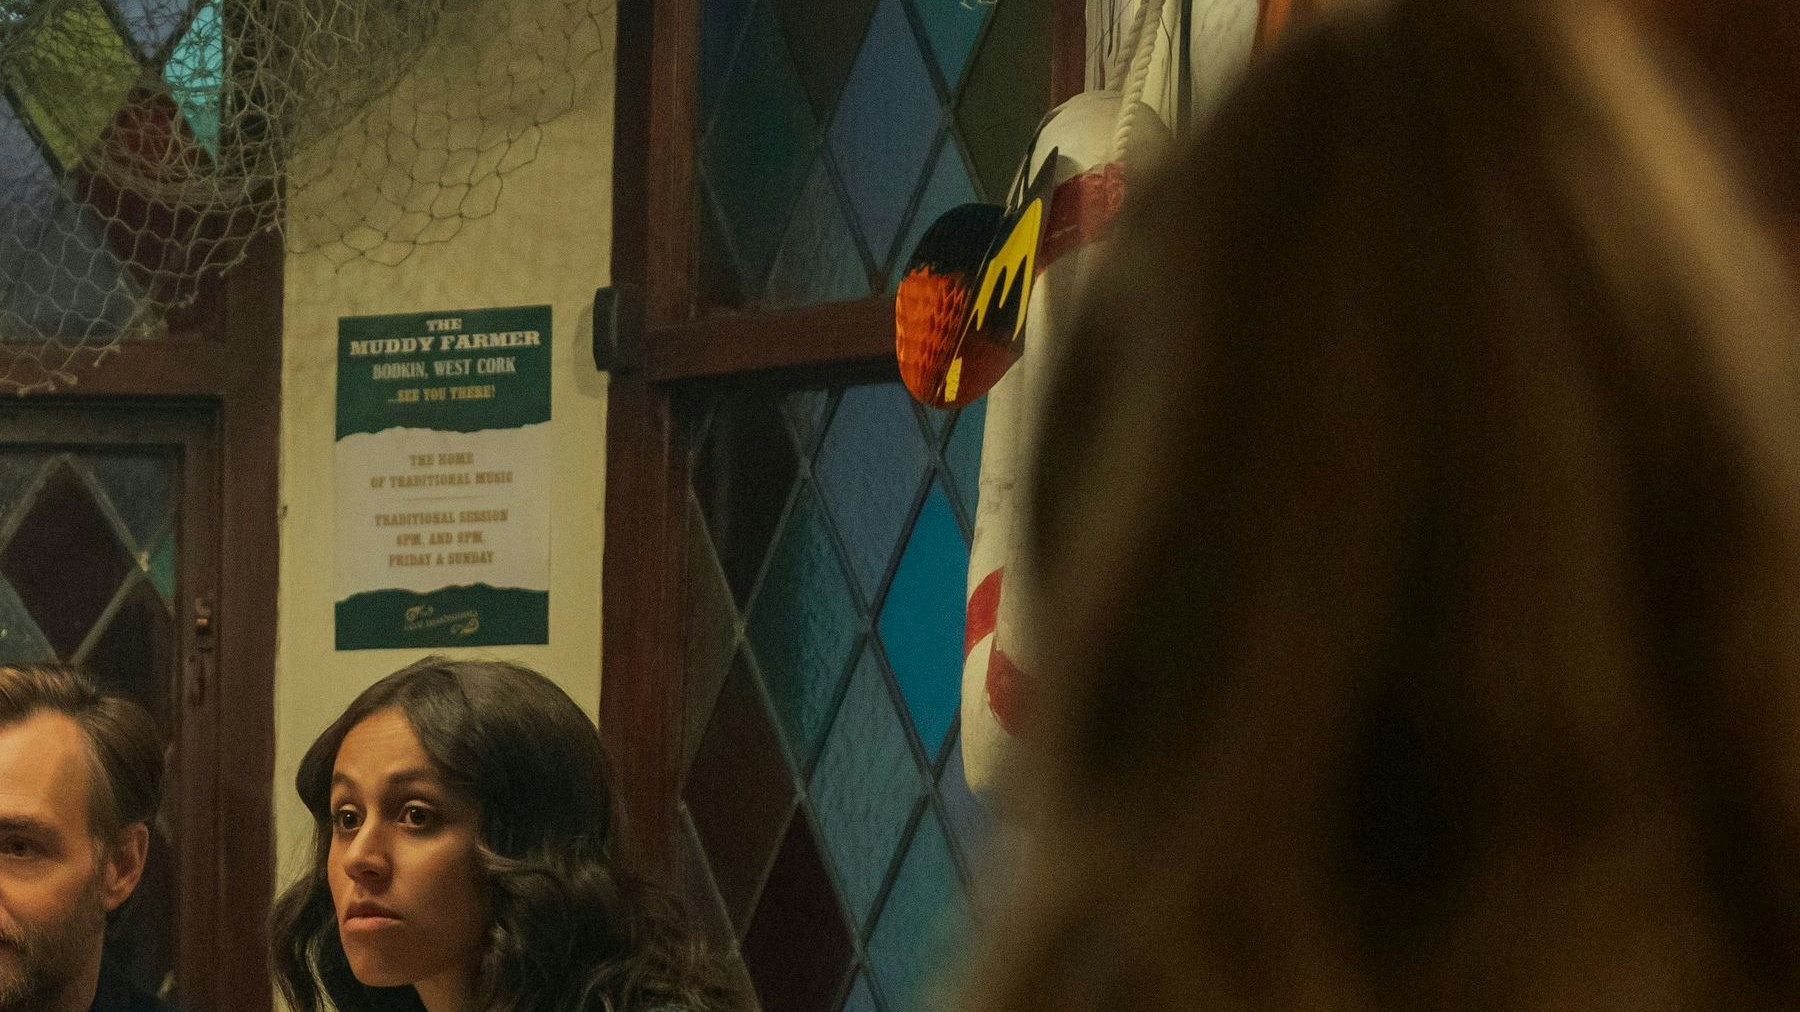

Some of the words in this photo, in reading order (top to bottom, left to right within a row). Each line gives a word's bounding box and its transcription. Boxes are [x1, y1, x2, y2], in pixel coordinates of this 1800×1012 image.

[426, 318, 462, 332] THE
[350, 336, 436, 356] MUDDY
[439, 331, 541, 351] FARMER
[434, 358, 473, 377] WEST
[477, 356, 516, 374] CORK
[423, 386, 446, 401] YOU
[450, 384, 496, 400] THERE!
[409, 453, 435, 467] THE
[438, 451, 474, 466] HOME
[370, 475, 386, 490] OF
[389, 472, 471, 488] TRADITIONAL
[475, 470, 514, 485] MUSIC
[375, 511, 456, 527] TRADITIONAL
[459, 508, 509, 523] SESSION
[429, 532, 453, 546] AND
[389, 553, 432, 568] FRIDAY
[448, 550, 495, 566] SUNDAY
